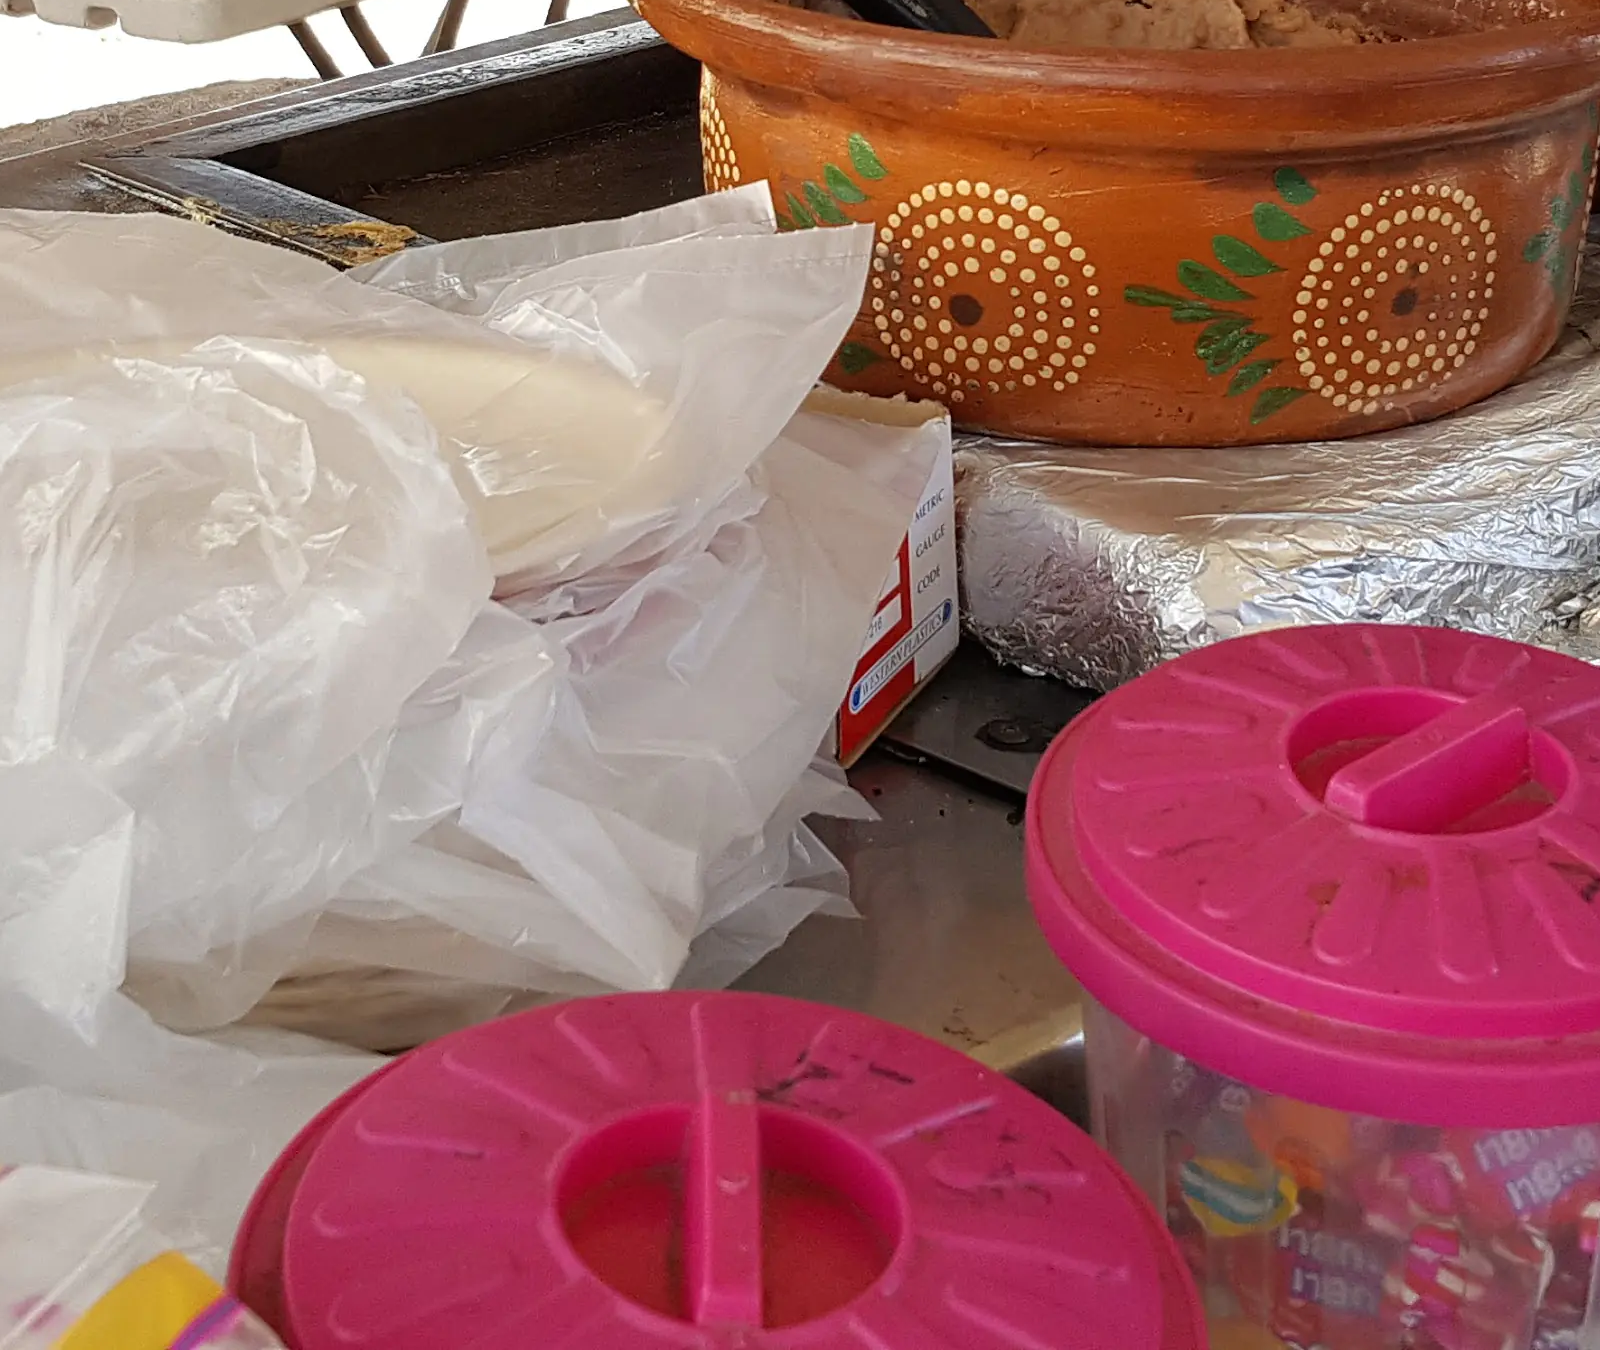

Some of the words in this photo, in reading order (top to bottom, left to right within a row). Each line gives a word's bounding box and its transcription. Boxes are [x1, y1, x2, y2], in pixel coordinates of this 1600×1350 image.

[914, 488, 945, 523] METRIC
[915, 523, 946, 558] GAUGE
[917, 564, 941, 594] CODE
[862, 647, 903, 696] WESTERN
[903, 612, 942, 657] PLASTICS
